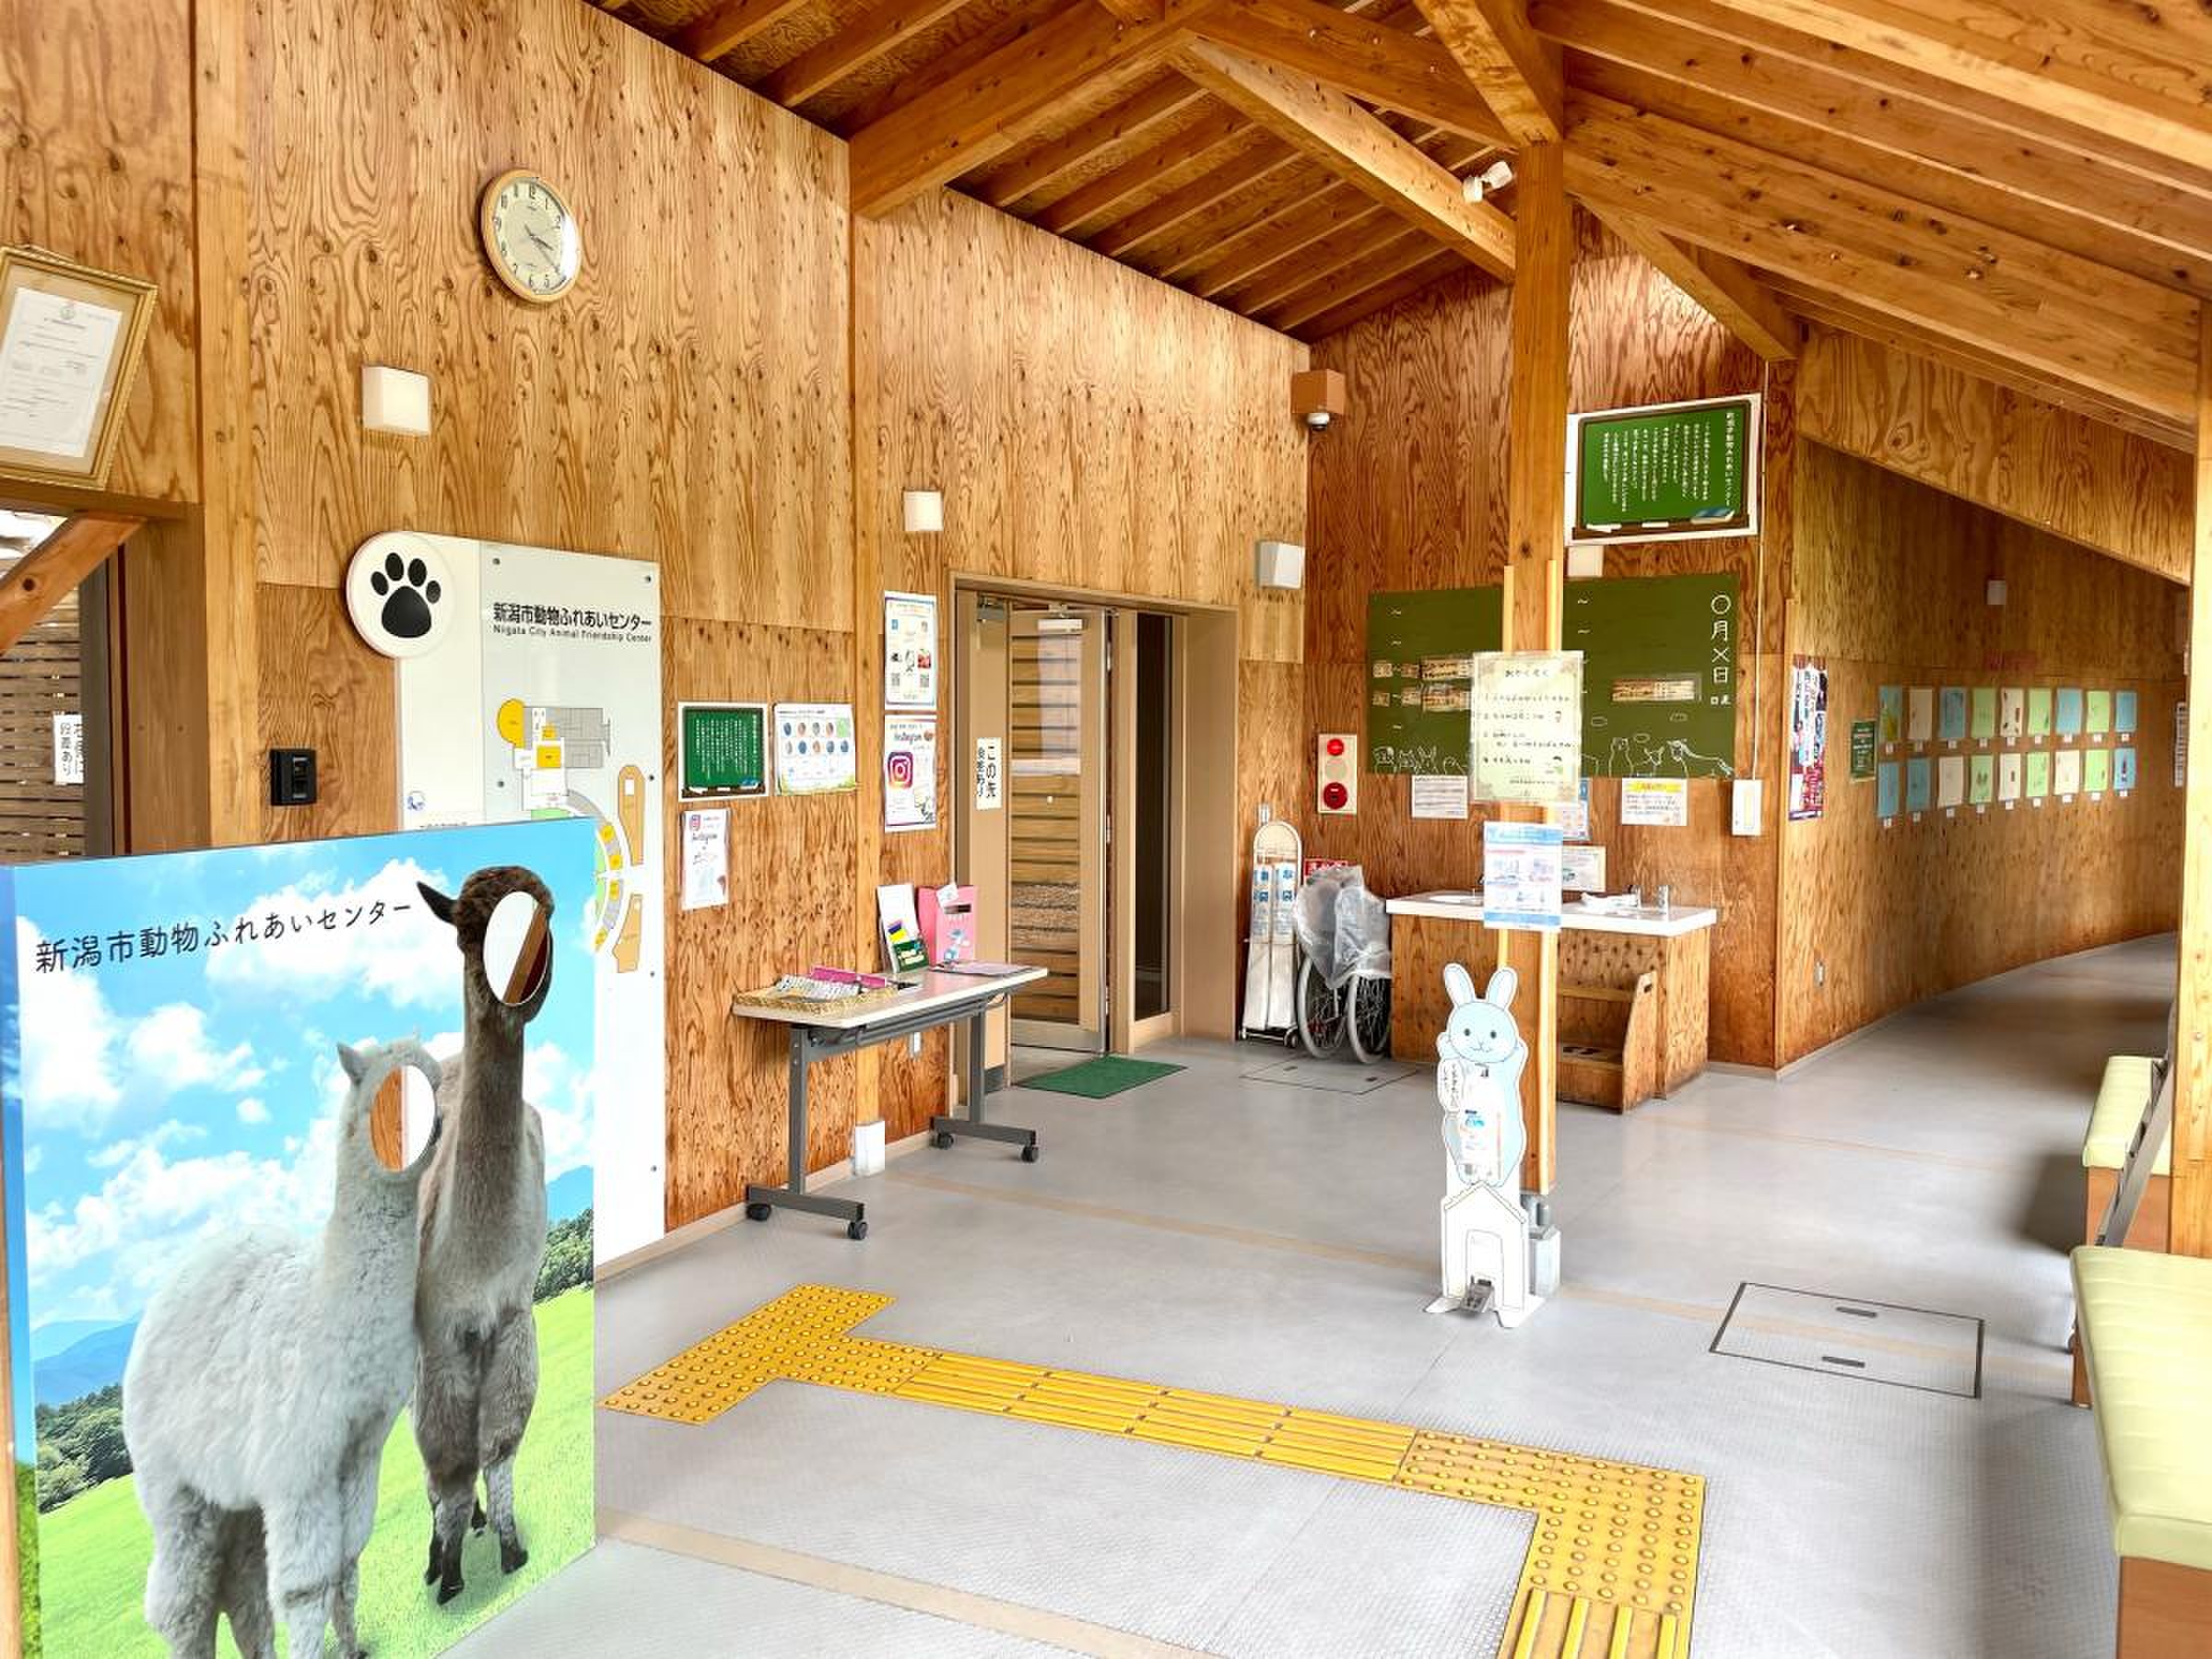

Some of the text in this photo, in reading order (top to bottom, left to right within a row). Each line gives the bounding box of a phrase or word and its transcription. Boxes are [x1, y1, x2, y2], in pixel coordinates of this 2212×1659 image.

[493, 602, 652, 630] 新潟市動物ふれあいセンター
[493, 624, 652, 642] Niigata City Animal Friendship Center
[986, 744, 996, 798] この先
[35, 900, 412, 974] 新潟市動物ふれあいセンター
